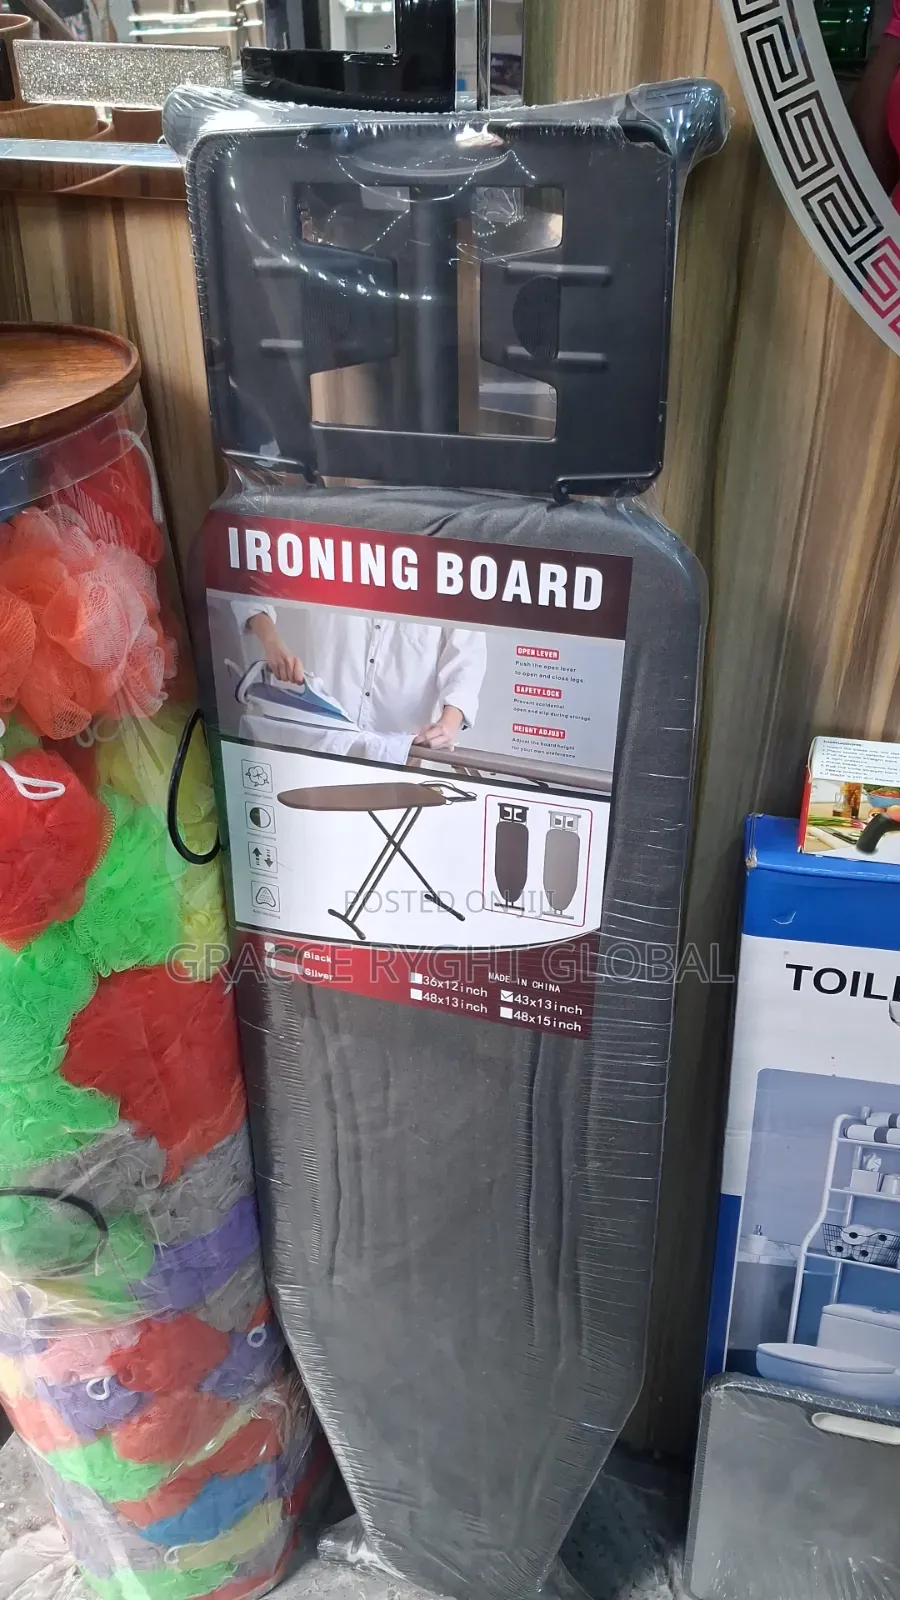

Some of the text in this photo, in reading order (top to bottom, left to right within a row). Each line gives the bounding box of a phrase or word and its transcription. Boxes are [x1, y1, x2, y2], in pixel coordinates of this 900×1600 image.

[228, 527, 603, 611] IRONING BOARD
[518, 648, 558, 659] OPEN LEVER
[516, 686, 560, 698] SAFETY LOCK
[514, 724, 564, 738] HEIGHT ADJUST
[304, 951, 332, 963] Black
[304, 968, 333, 980] Silver
[488, 972, 561, 994] MADE IN CHINA
